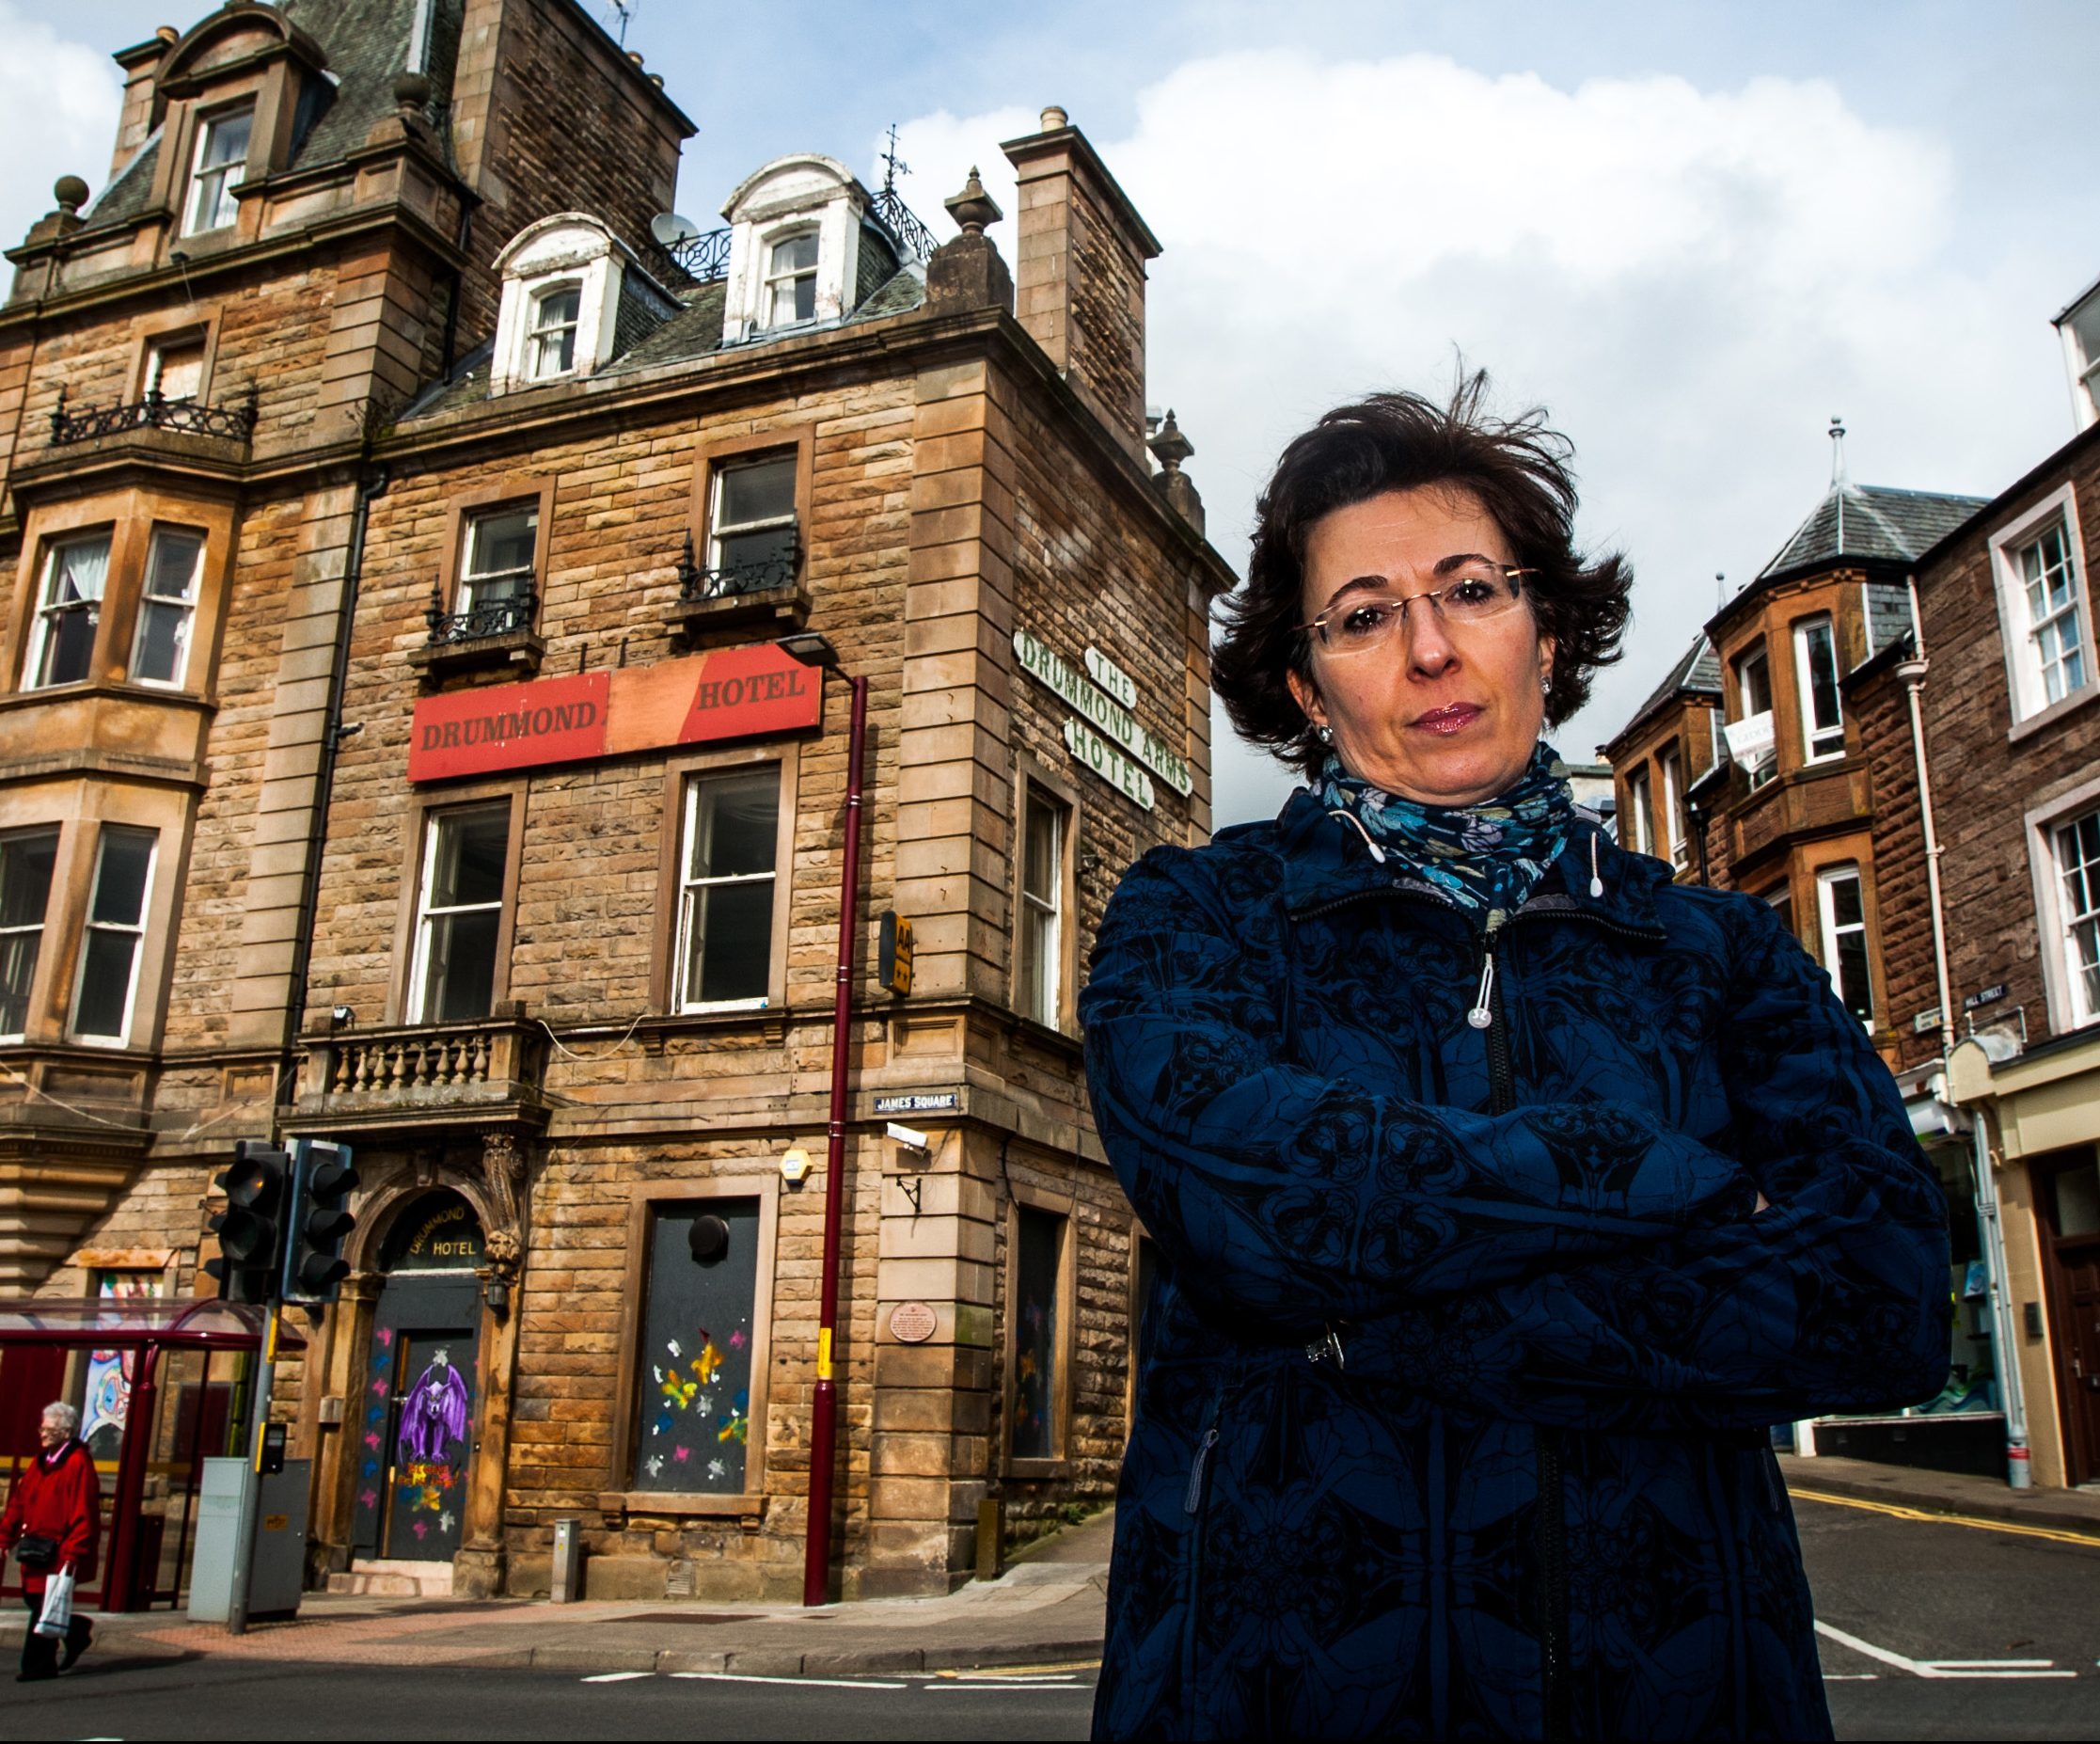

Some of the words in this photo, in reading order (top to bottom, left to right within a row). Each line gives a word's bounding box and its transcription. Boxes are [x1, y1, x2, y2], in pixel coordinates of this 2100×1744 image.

[1095, 653, 1130, 703] THE
[420, 700, 597, 752] DRUMMOND
[696, 669, 806, 710] HOTEL
[1022, 633, 1133, 745] DRUMMOND
[1142, 728, 1188, 790] ARMS
[1071, 720, 1149, 806] HOTEL
[897, 926, 910, 953] AA
[1966, 997, 1979, 1007] HILL
[1981, 986, 2003, 1001] STREET
[877, 1097, 911, 1110] JAMES
[914, 1094, 953, 1108] SQUARE
[410, 1207, 465, 1254] DRUMMOND
[434, 1242, 476, 1255] HOTEL
